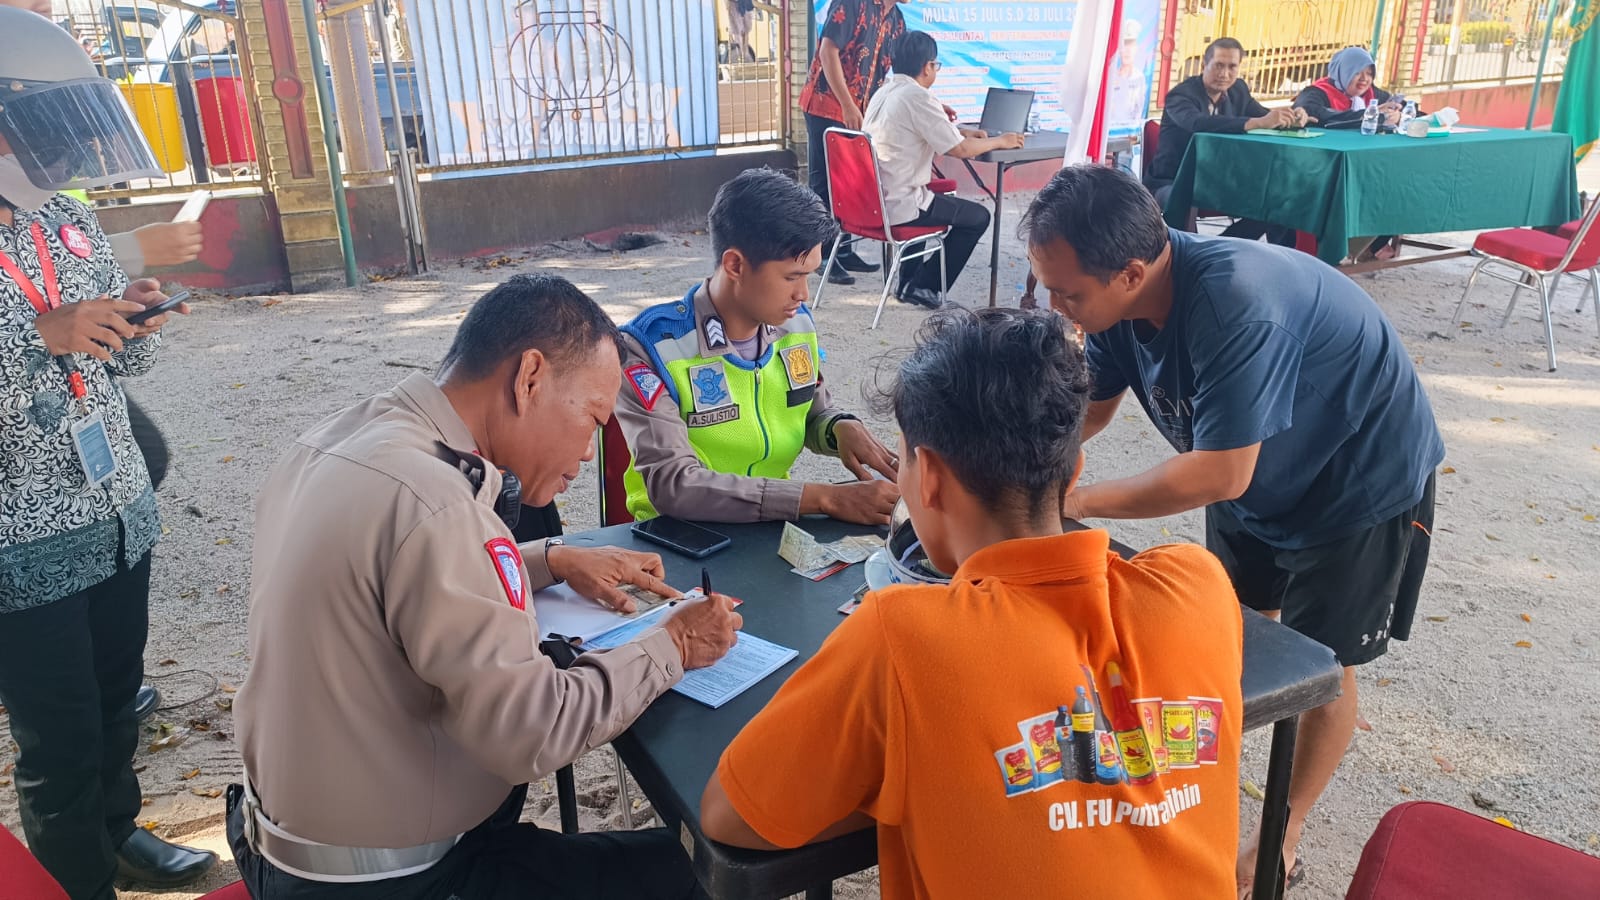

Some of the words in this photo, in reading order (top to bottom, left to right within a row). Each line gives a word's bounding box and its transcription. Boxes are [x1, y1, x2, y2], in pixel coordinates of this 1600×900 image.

[922, 7, 959, 23] MULAI
[963, 7, 977, 22] 15
[982, 7, 1001, 22] JULI
[1043, 7, 1064, 22] JULI
[690, 408, 737, 425] A.SULISTIO
[1048, 801, 1083, 831] CV.
[1086, 798, 1113, 827] FU
